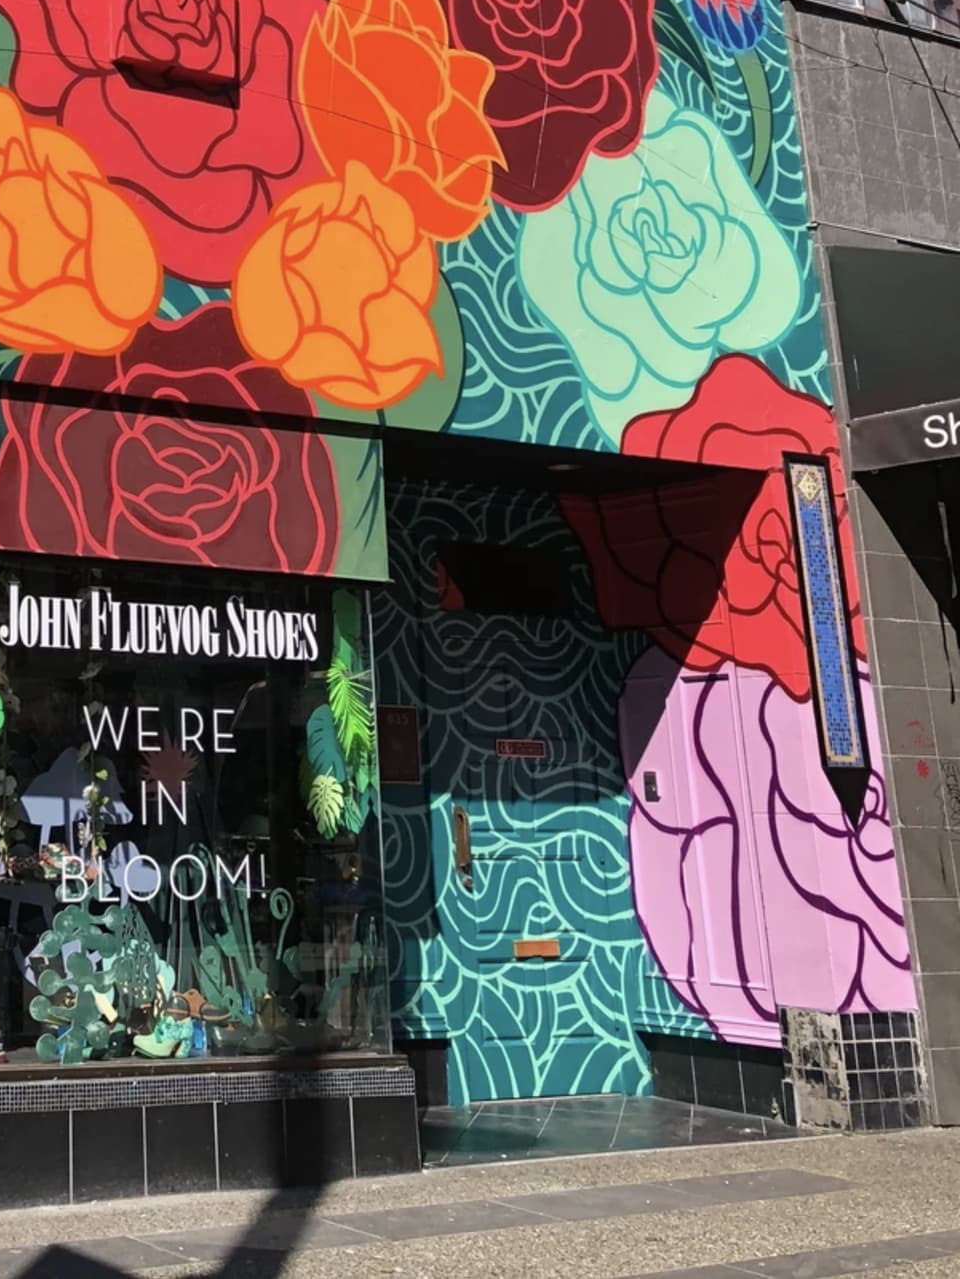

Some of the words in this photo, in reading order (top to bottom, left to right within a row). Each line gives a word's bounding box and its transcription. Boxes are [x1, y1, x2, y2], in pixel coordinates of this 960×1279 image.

[0, 580, 83, 650] JOHN
[89, 586, 221, 657] FLUEVOG
[226, 596, 319, 662] SHOES
[141, 780, 187, 825] IN
[61, 853, 268, 902] BLOOM!
